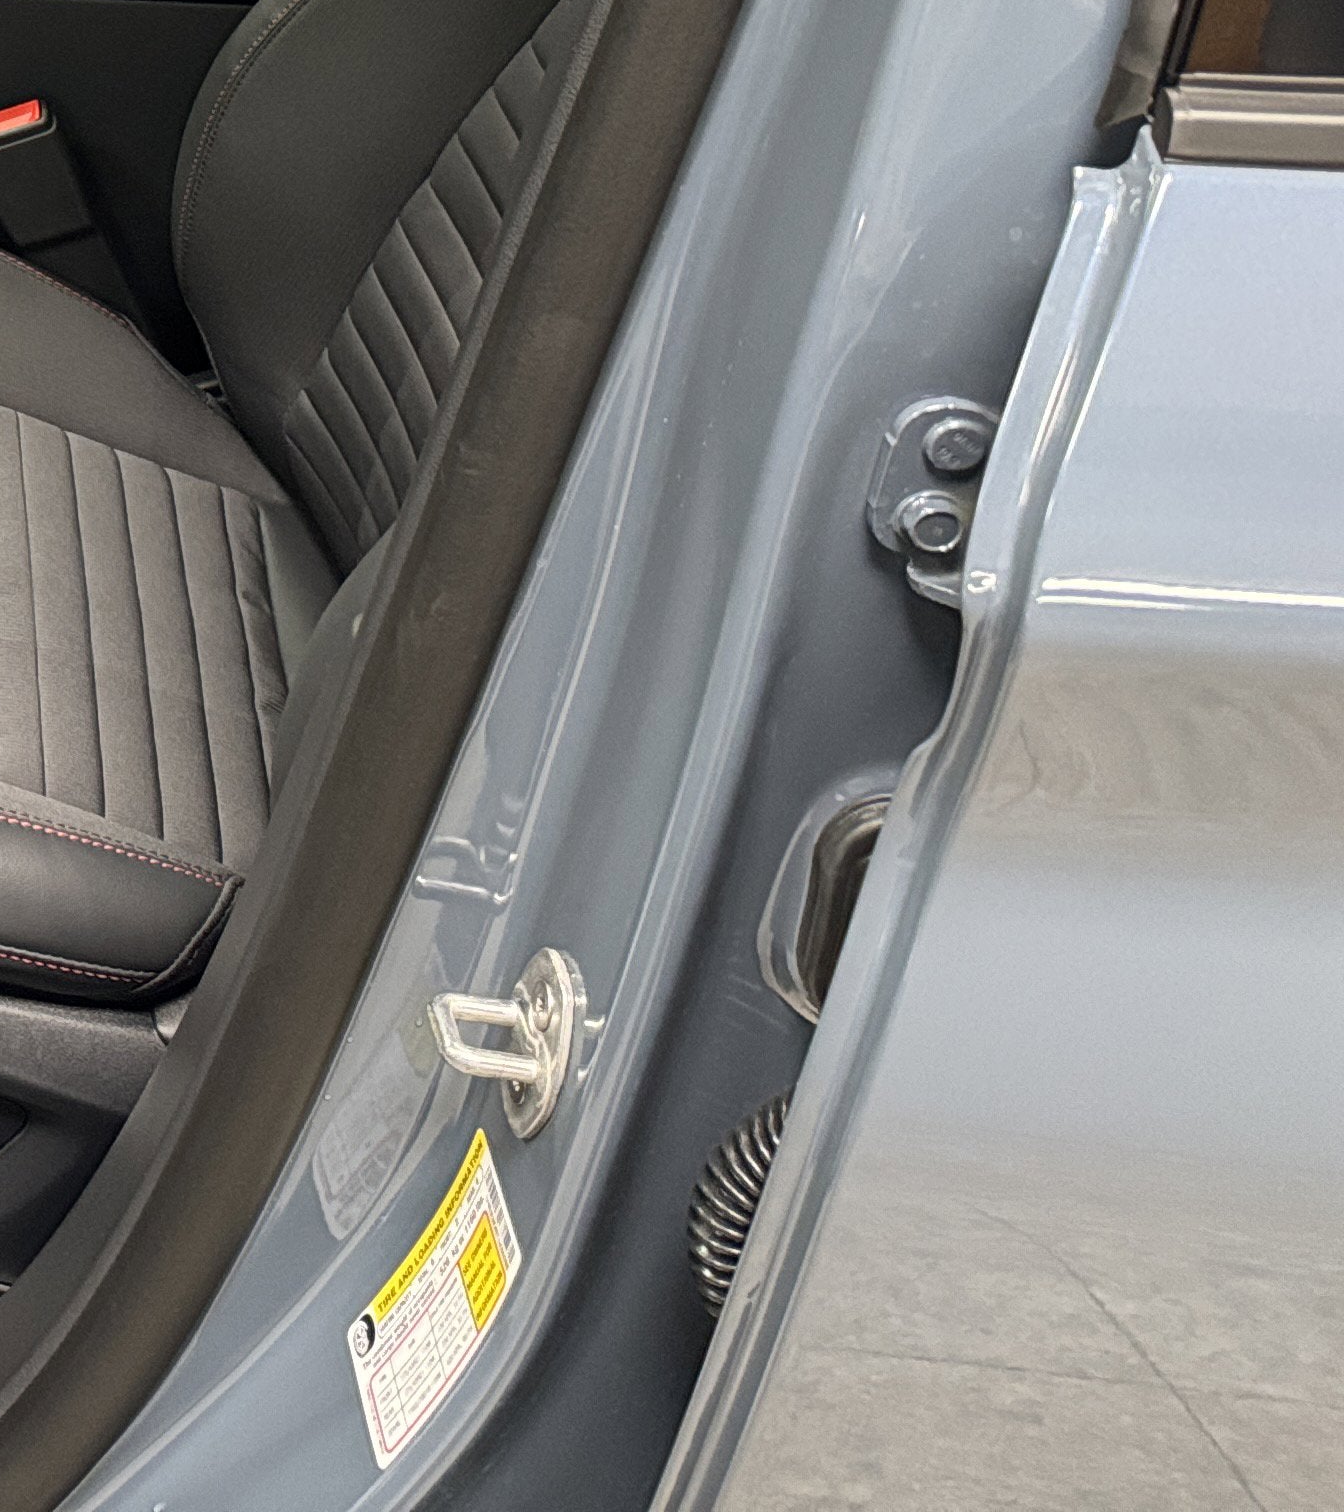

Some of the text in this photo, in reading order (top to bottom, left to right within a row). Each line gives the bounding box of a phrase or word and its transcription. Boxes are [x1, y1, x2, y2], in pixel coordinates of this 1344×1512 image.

[377, 1286, 397, 1313] TIRE
[398, 1264, 414, 1285] AND
[413, 1219, 445, 1266] LOADING
[443, 1140, 483, 1217] INFORMATION
